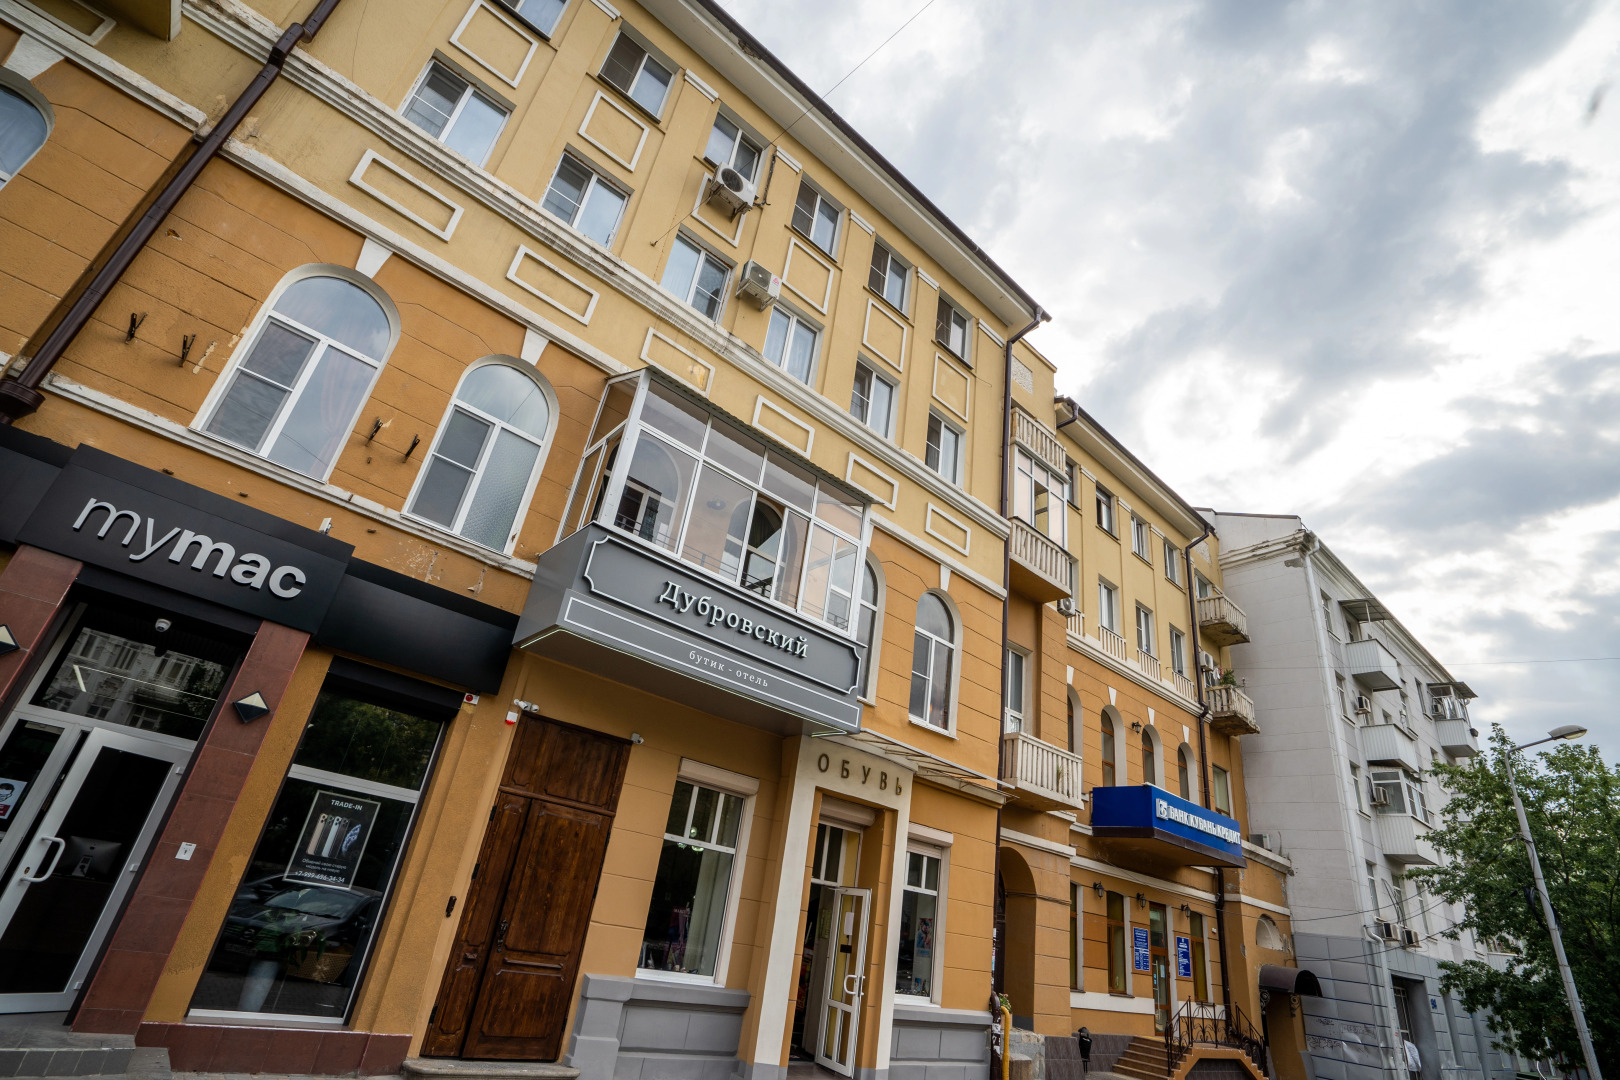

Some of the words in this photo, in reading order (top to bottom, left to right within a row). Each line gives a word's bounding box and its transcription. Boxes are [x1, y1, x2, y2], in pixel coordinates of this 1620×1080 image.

[72, 497, 307, 599] mymac
[659, 580, 809, 658] Дубровский
[689, 650, 725, 672] бутик
[735, 669, 768, 687] отель
[818, 753, 902, 796] ОБУВЬ
[331, 799, 363, 811] TRADE-IN
[1167, 805, 1189, 826] БАНК
[1188, 813, 1217, 837] КУБАНЬ
[1216, 824, 1241, 845] КРЕДИТ
